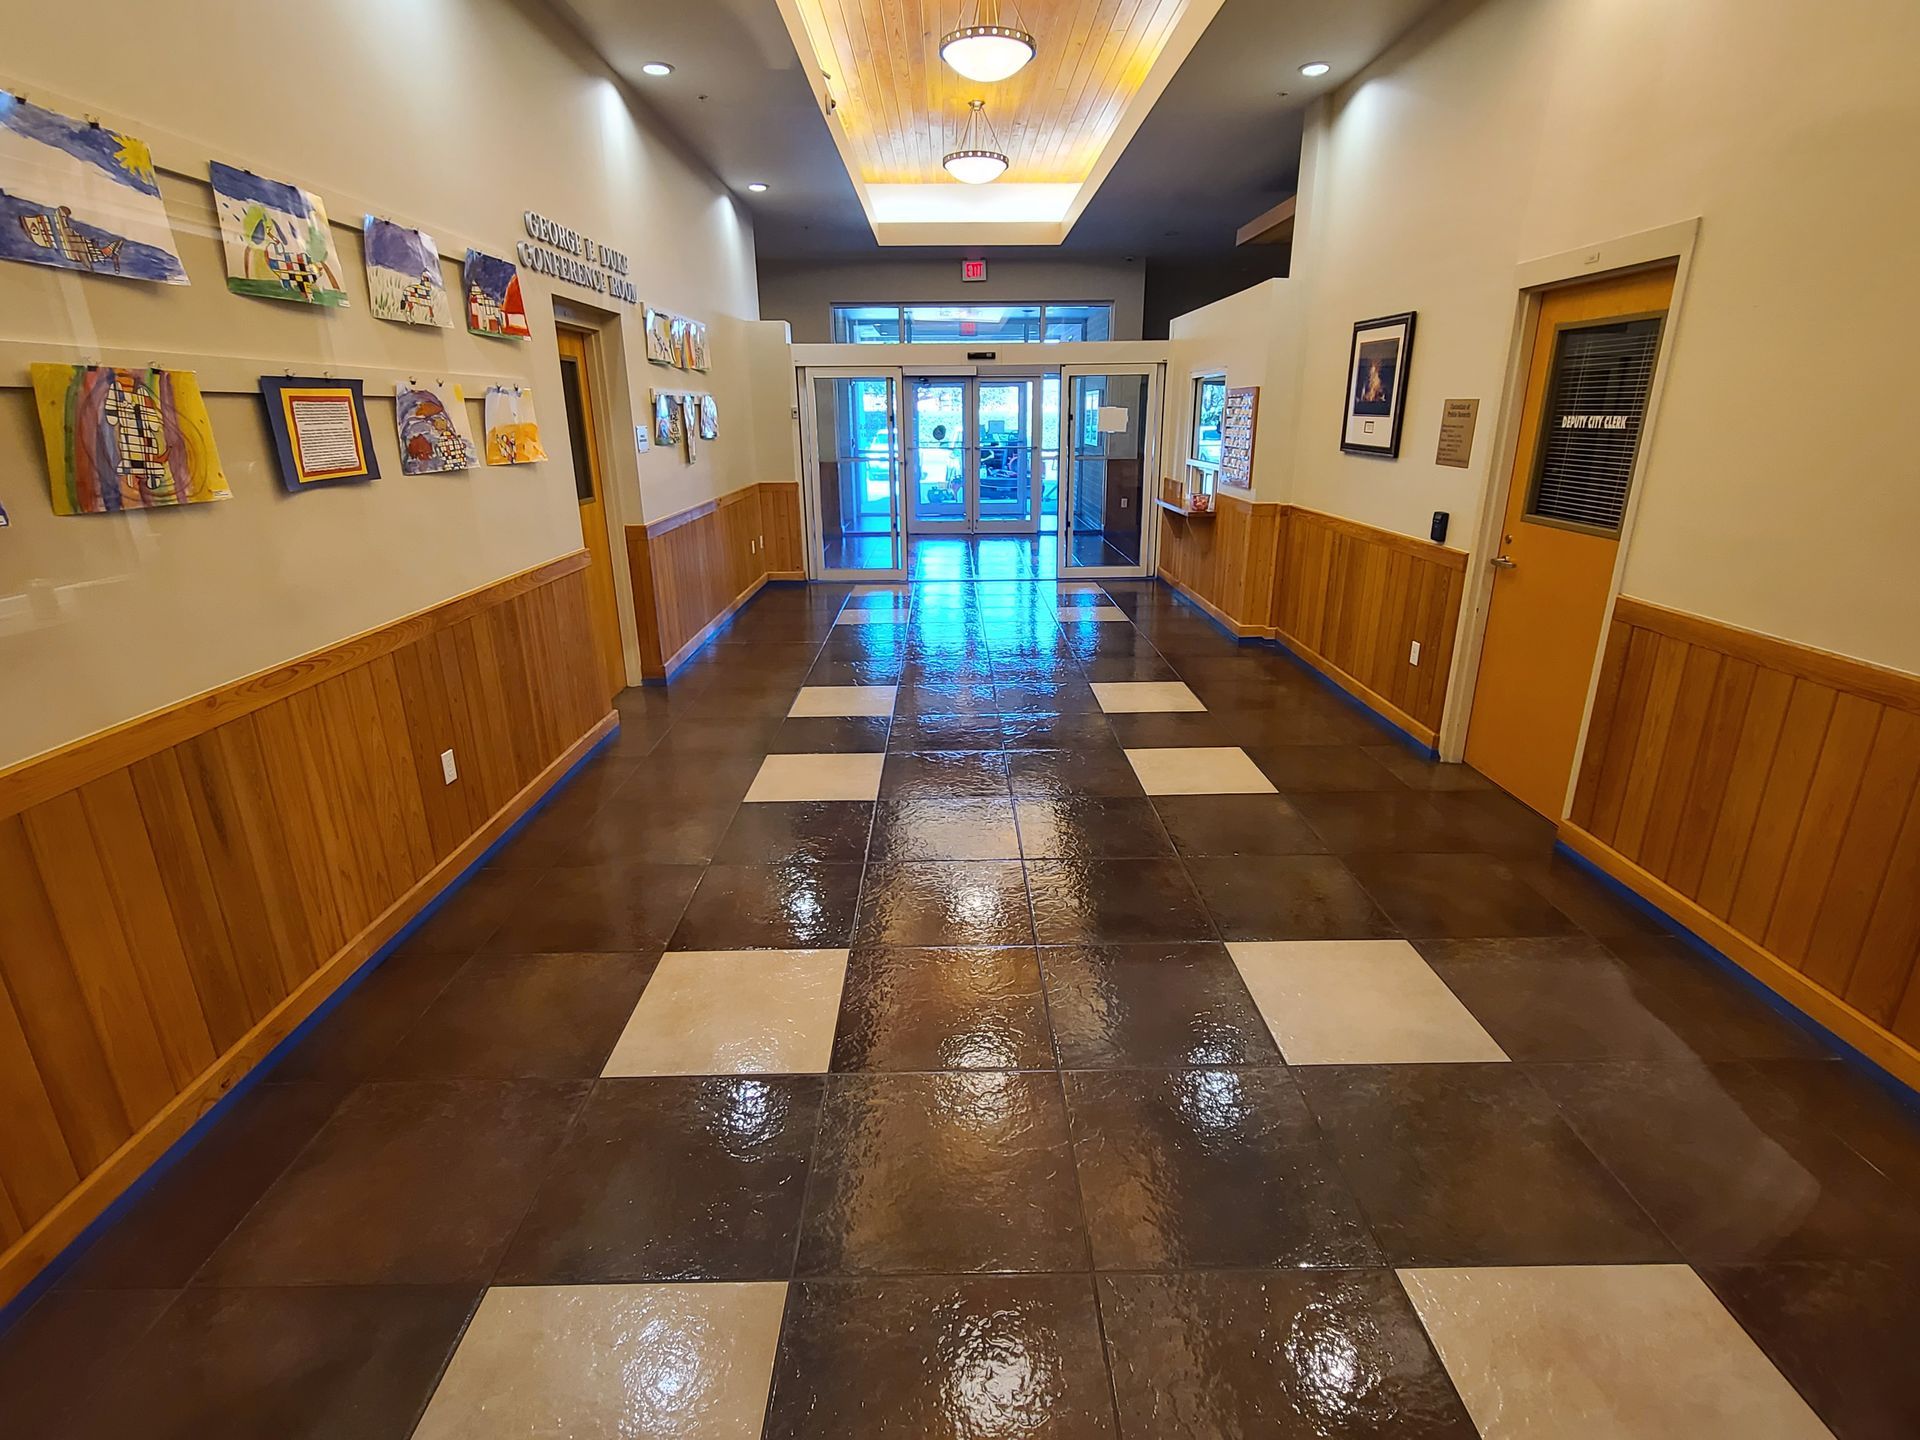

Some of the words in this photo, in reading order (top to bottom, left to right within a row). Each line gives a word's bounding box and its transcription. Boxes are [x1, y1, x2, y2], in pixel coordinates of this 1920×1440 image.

[524, 211, 582, 256] GEORGE
[598, 245, 629, 275] DUKE
[516, 241, 607, 293] CONFERENCE
[607, 275, 638, 303] ROOM
[966, 262, 984, 278] EXIT
[1561, 415, 1588, 428] DEPUTY
[1587, 415, 1605, 429] CITY
[1604, 416, 1628, 429] CLERK
